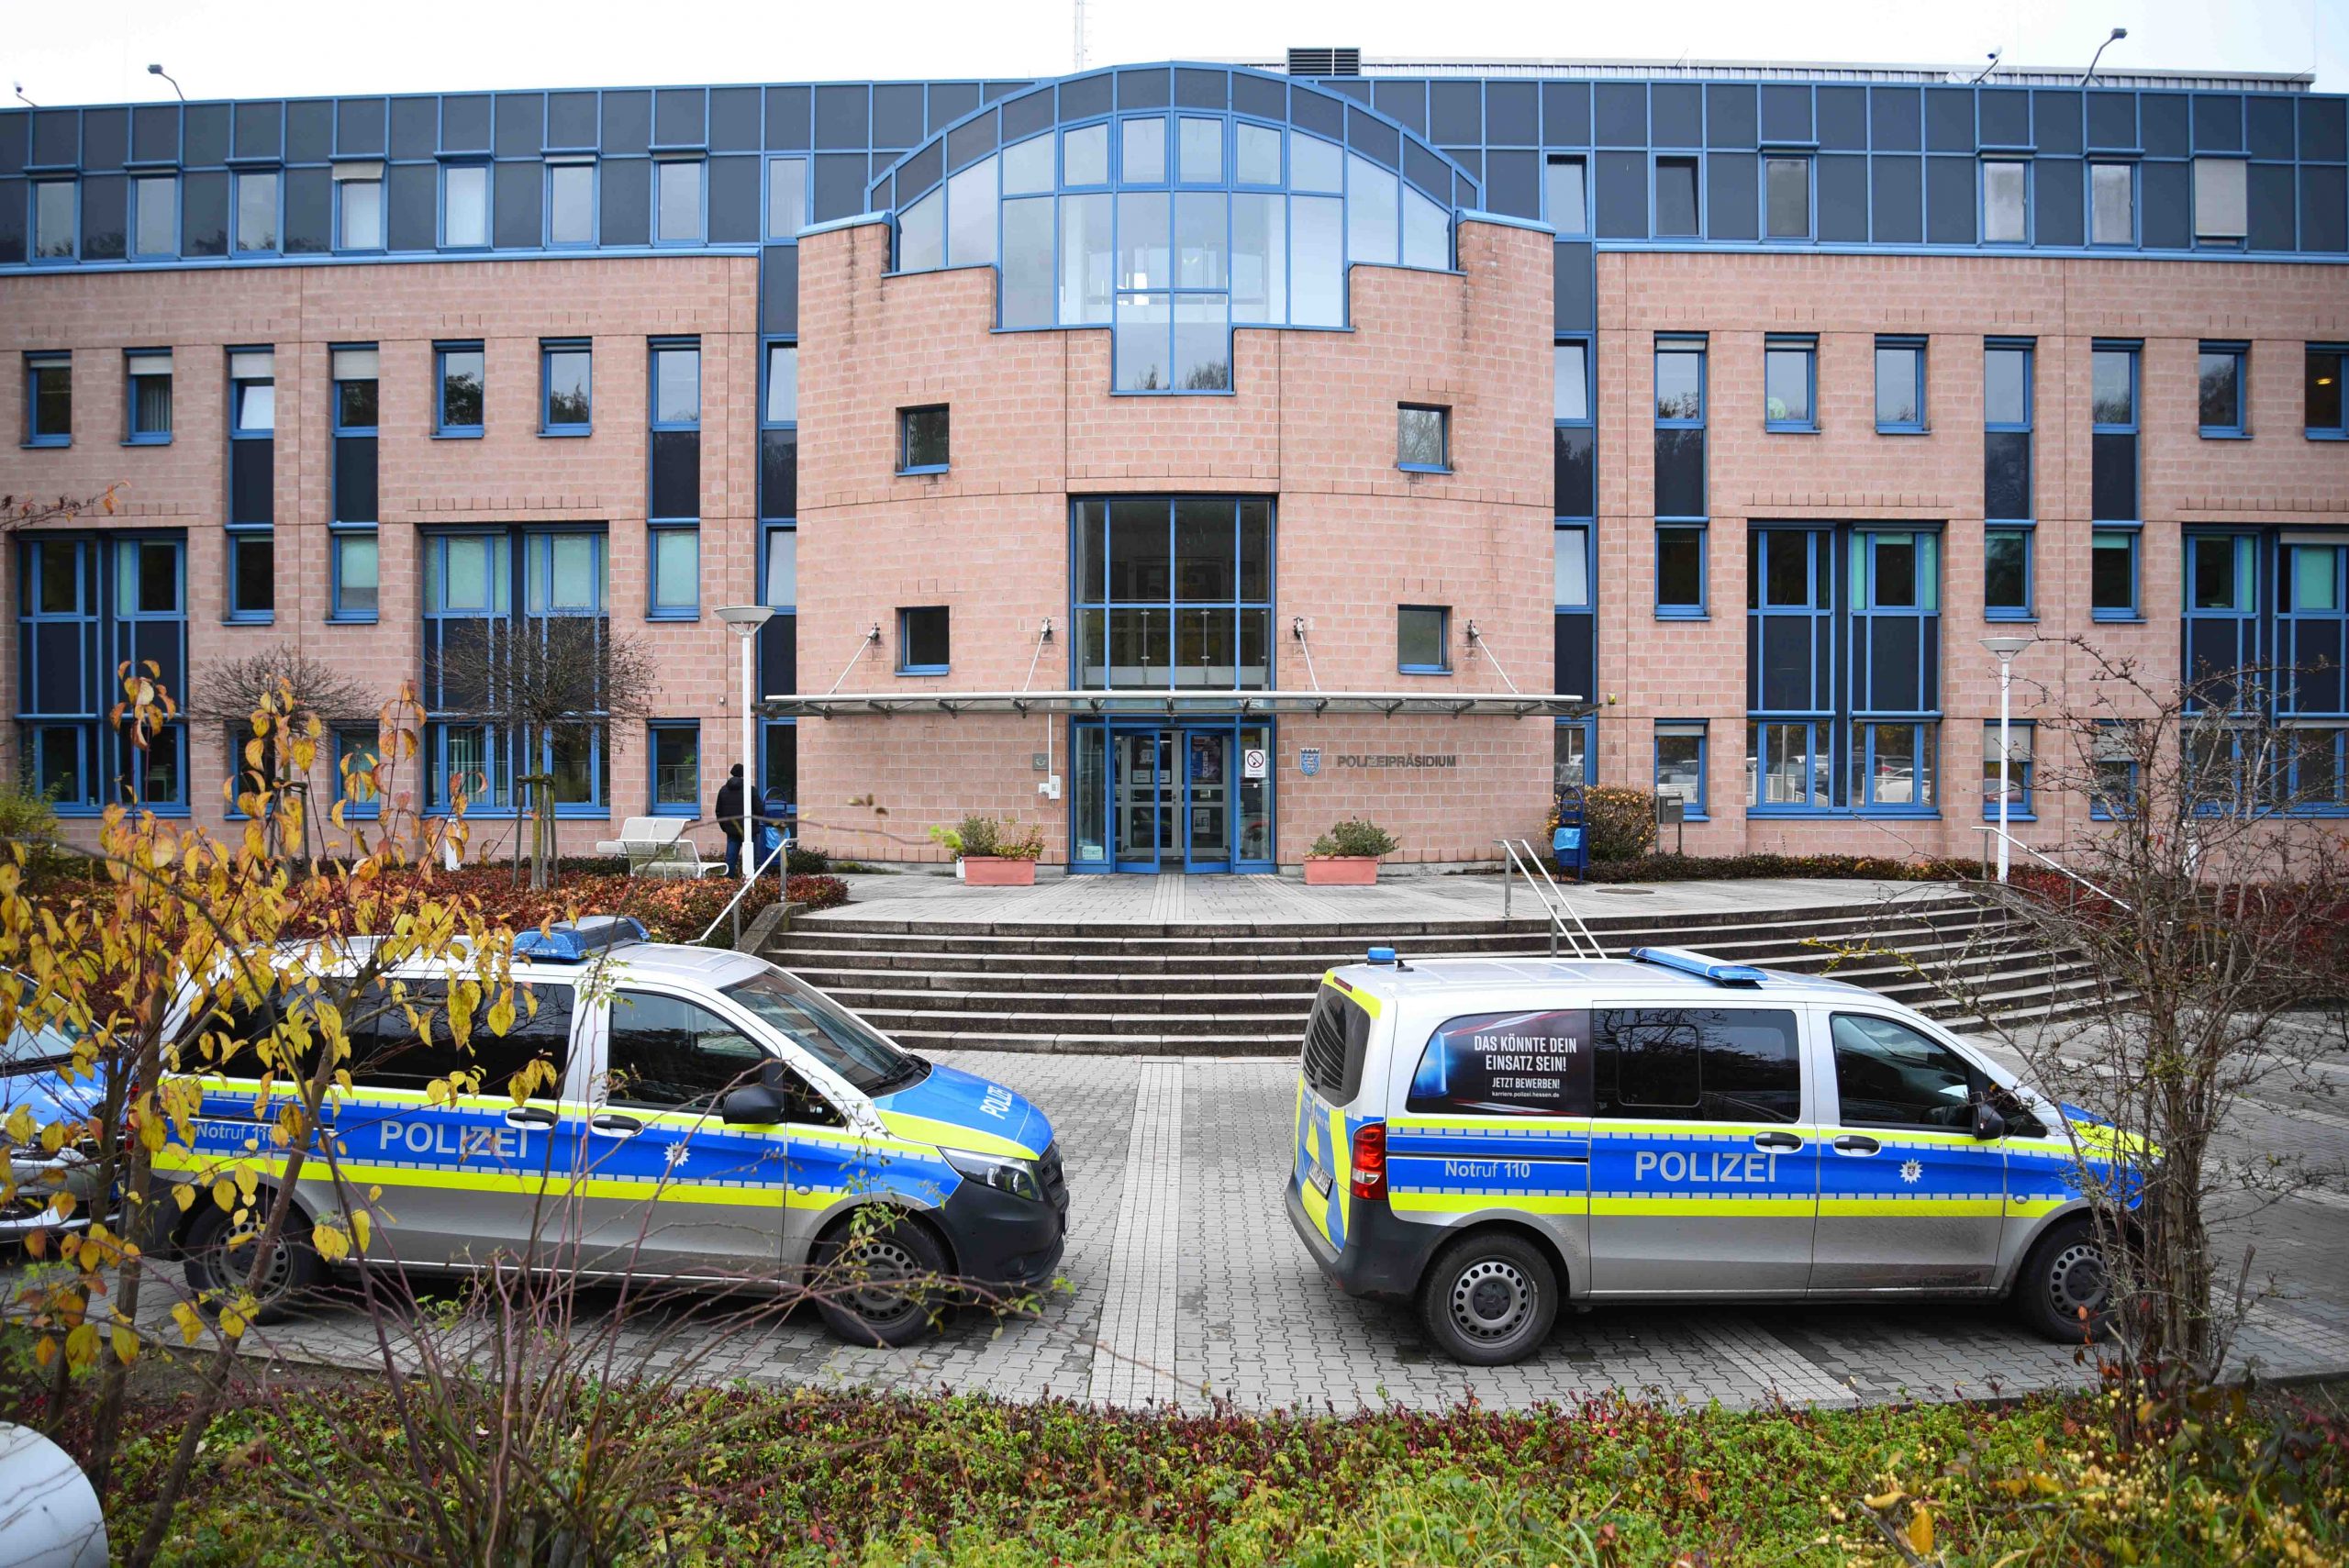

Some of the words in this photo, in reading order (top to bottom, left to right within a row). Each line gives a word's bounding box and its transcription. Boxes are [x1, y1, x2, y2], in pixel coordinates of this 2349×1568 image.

[1337, 752, 1456, 768] POLIZEIPRÄSIDIUM
[1474, 1035, 1497, 1051] DAS
[1500, 1033, 1546, 1052] KÖNNTE
[1549, 1037, 1577, 1053] DEIN
[1486, 1054, 1533, 1072] EINSATZ
[1535, 1056, 1566, 1073] SEIN!
[1491, 1077, 1514, 1089] JETZT
[1515, 1078, 1560, 1090] BEWERBEN!
[1491, 1090, 1560, 1098] karriere.polizei.hessen.de
[195, 1122, 248, 1140] Notruf
[251, 1126, 279, 1142] 11
[379, 1120, 528, 1159] POLIZEI
[1445, 1161, 1498, 1178] Notruf
[1504, 1162, 1531, 1178] 110
[1635, 1151, 1776, 1183] POLIZEI
